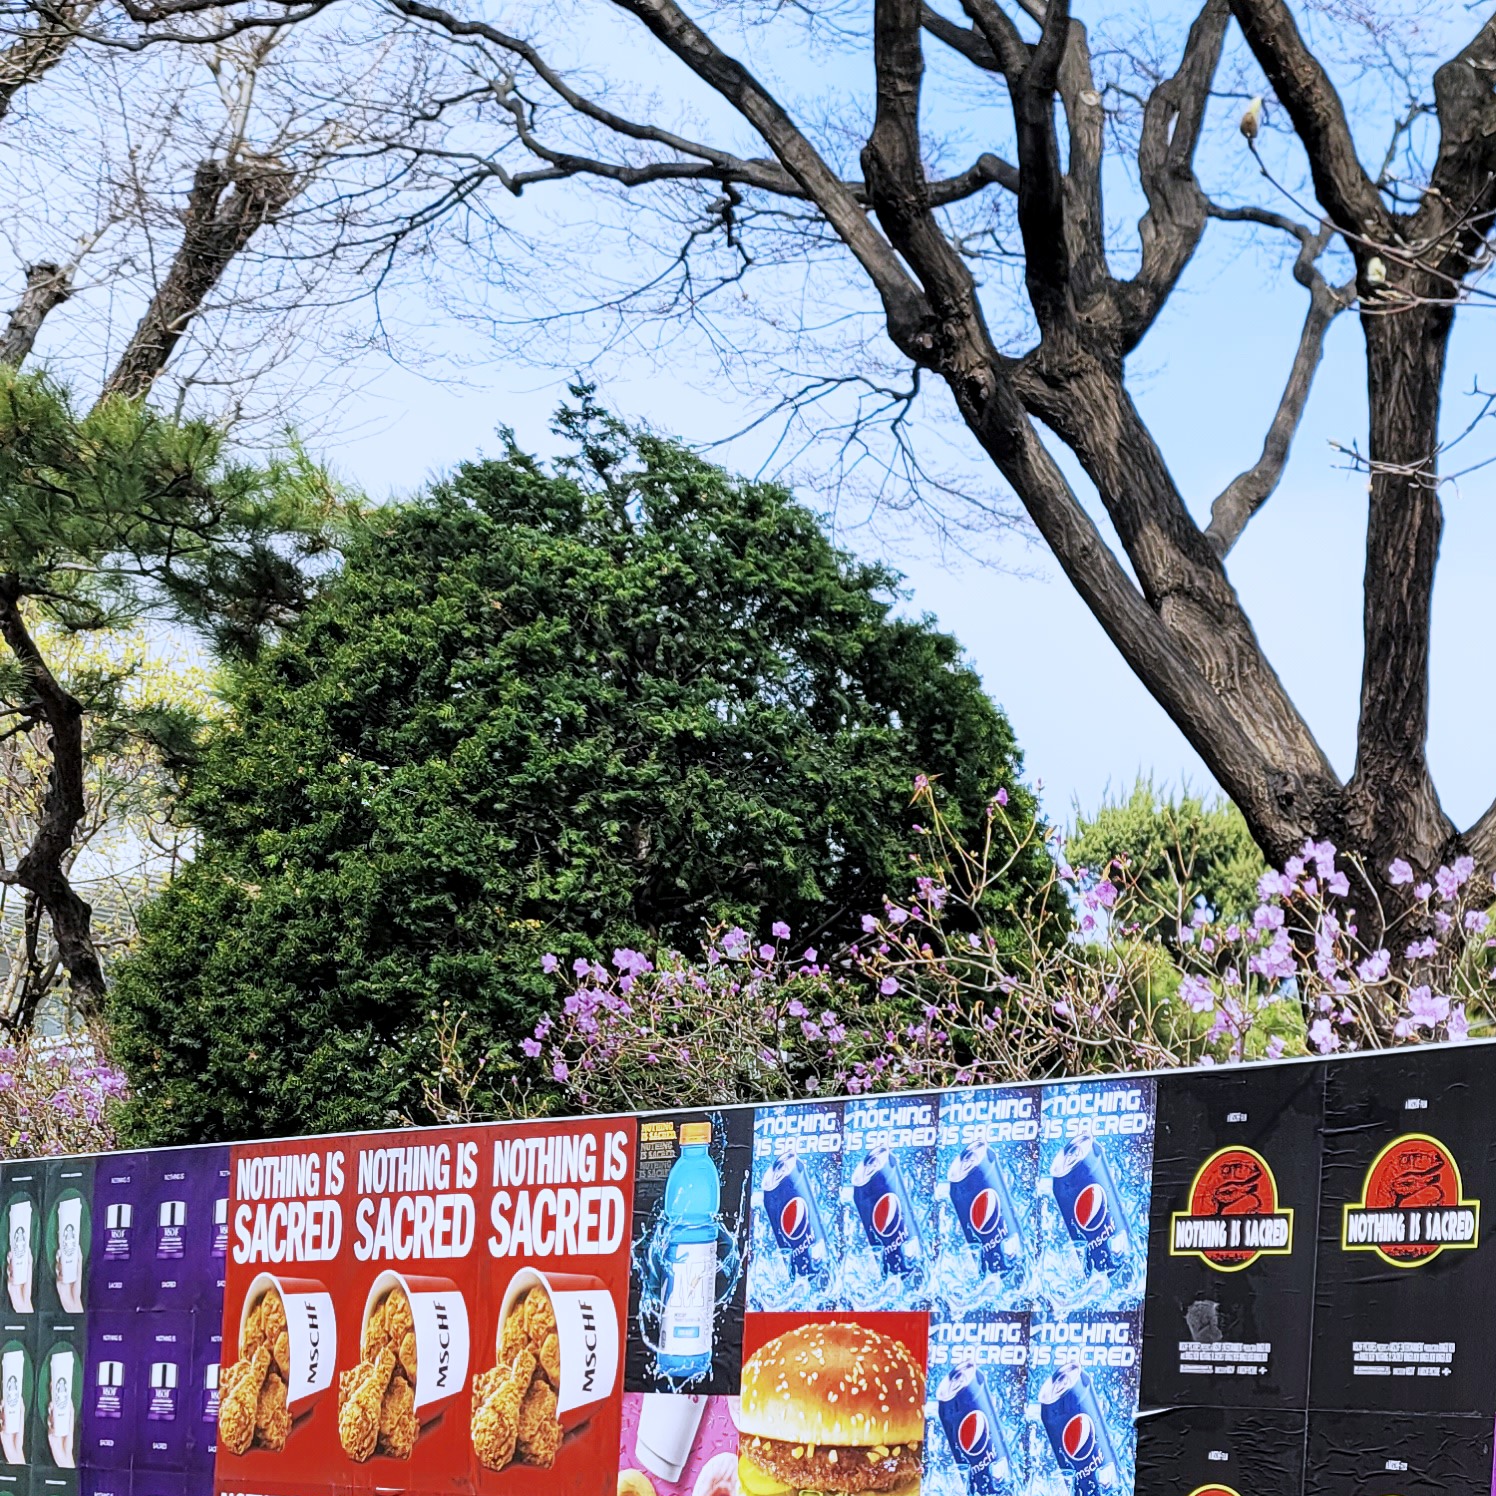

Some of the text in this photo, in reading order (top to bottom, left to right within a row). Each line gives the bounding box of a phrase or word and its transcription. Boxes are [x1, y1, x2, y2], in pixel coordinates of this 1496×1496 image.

[236, 1151, 345, 1200] NOTHING IS
[358, 1142, 478, 1194] NOTHING IS
[493, 1131, 627, 1187] NOTHING IS
[232, 1200, 342, 1264] SACRED
[353, 1194, 475, 1262] SACRED
[487, 1185, 624, 1258] SACRED
[1349, 1210, 1474, 1243] NOTHING IS SACRED
[305, 1300, 318, 1384] MSCHF
[436, 1300, 447, 1387] MSCHF
[578, 1300, 593, 1392] MSCHF
